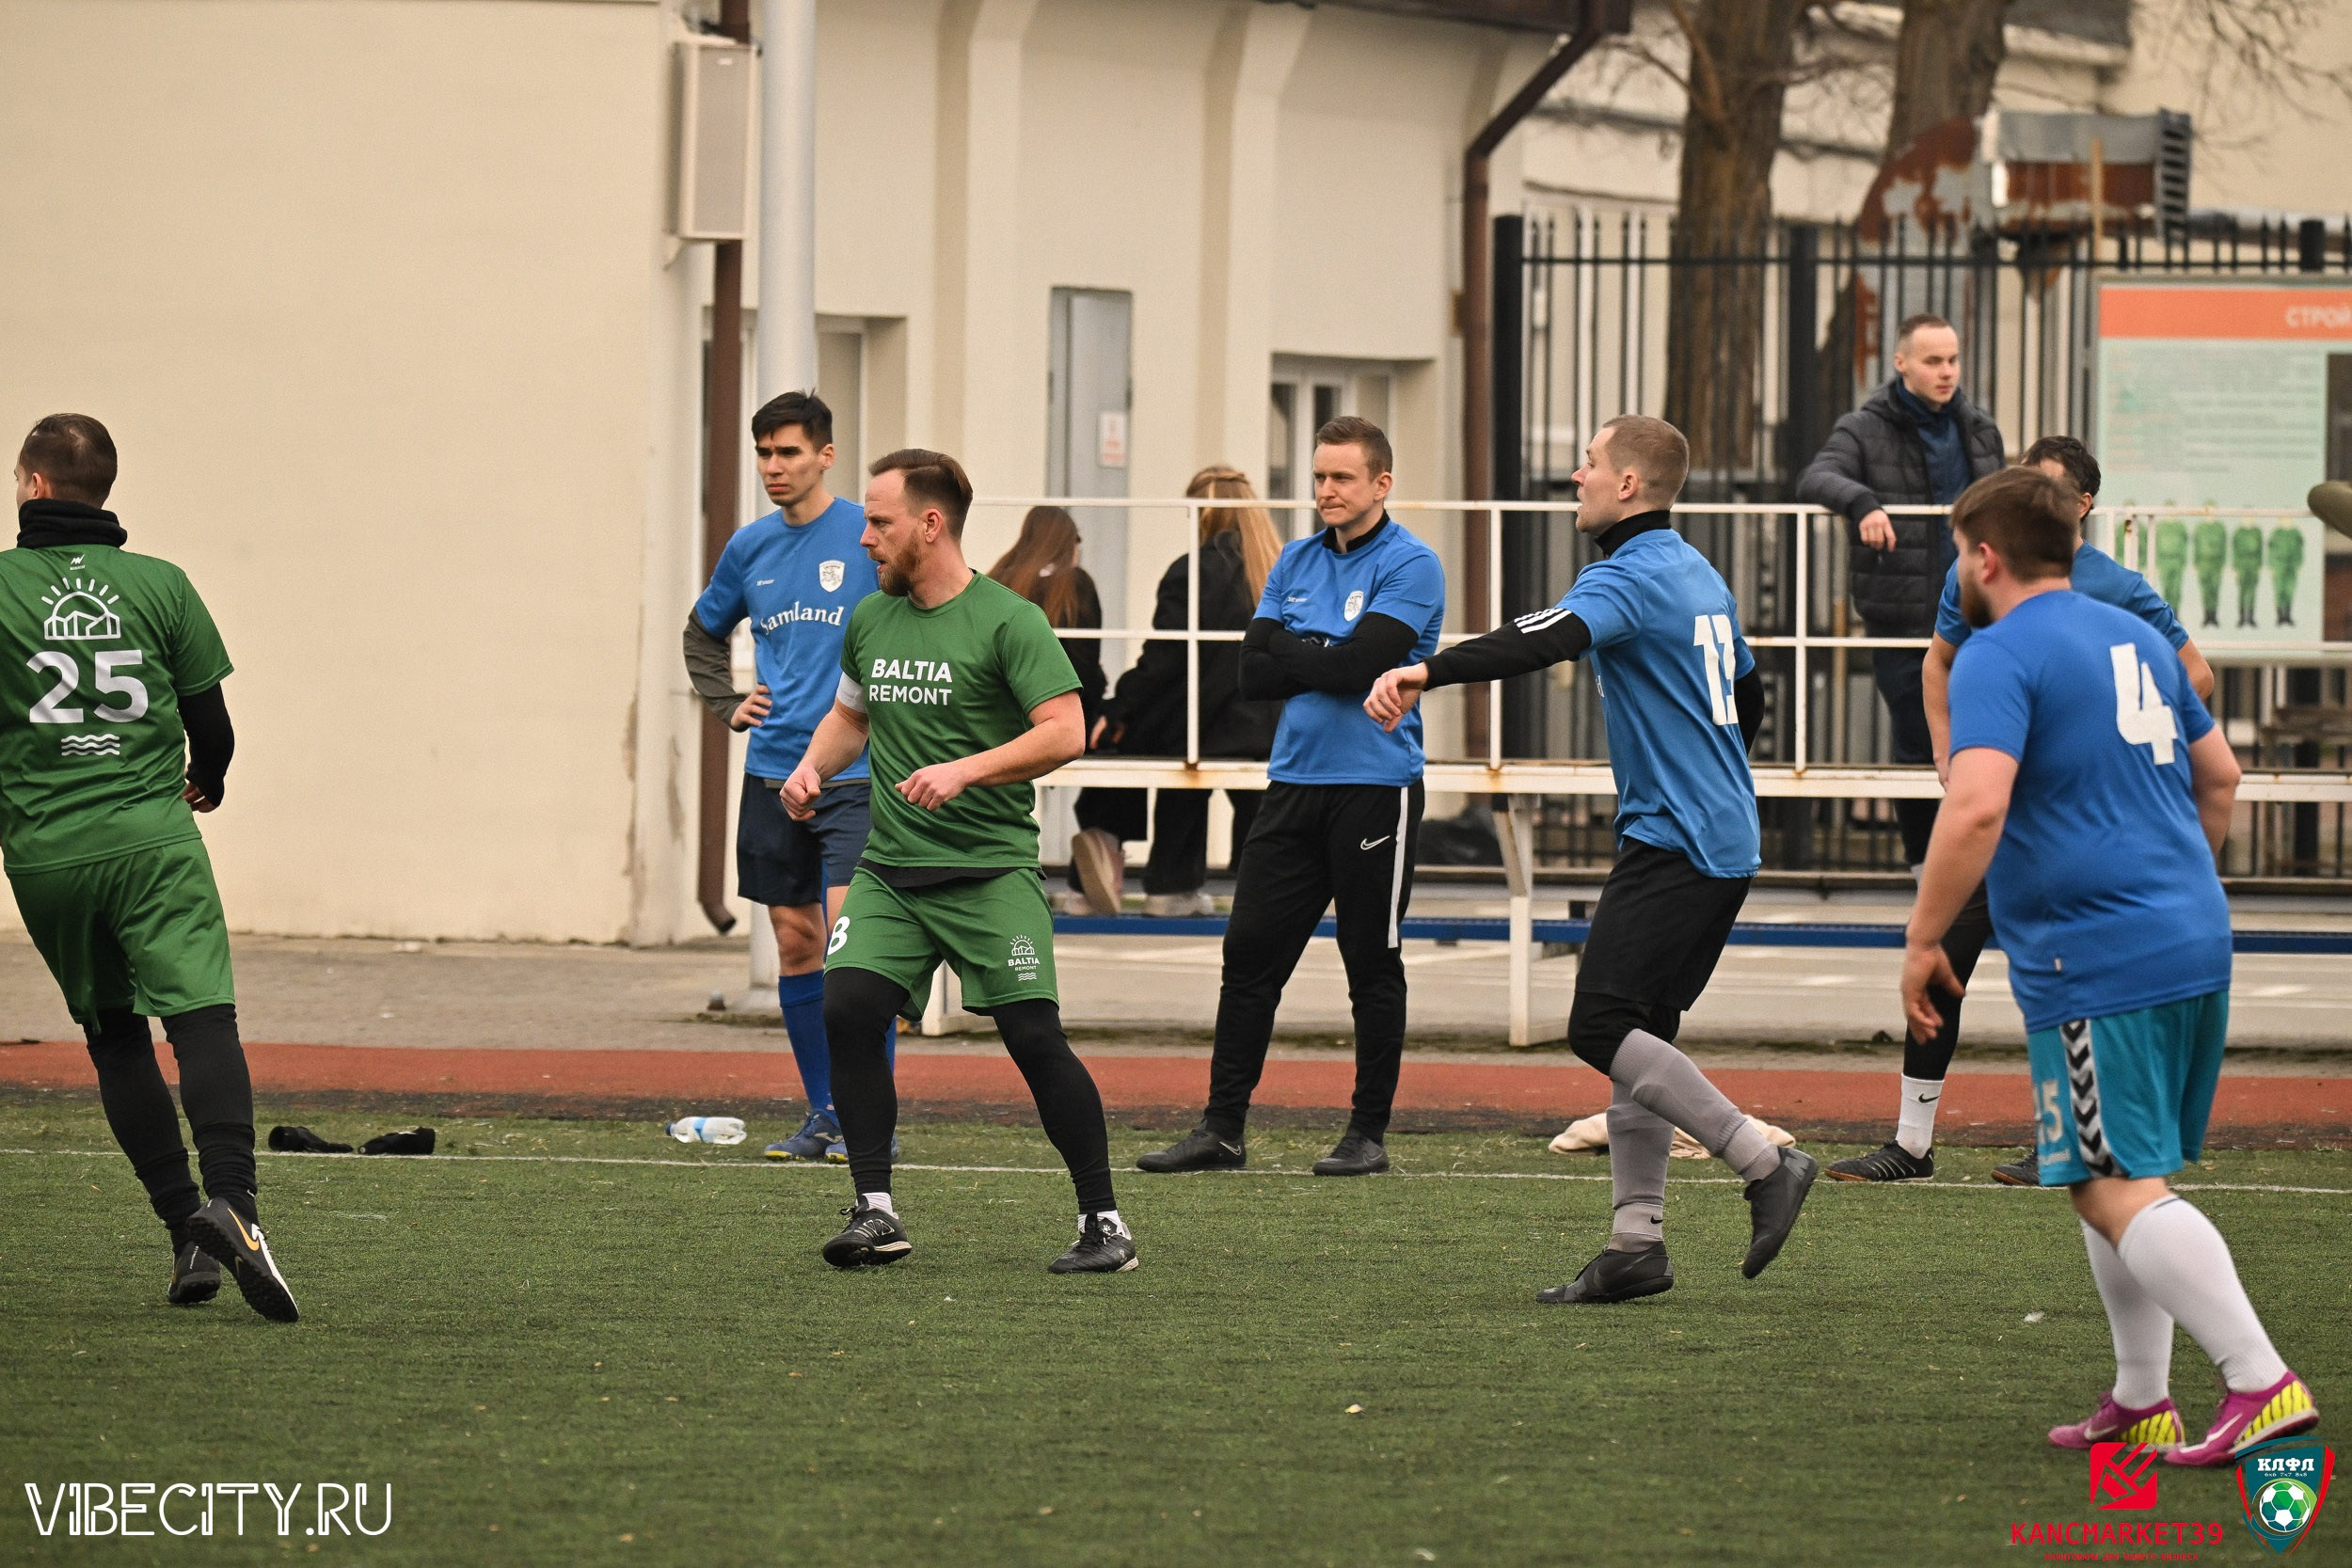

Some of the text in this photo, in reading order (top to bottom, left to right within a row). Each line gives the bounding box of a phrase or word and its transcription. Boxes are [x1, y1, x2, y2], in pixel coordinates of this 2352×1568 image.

[760, 600, 844, 636] Samland
[871, 658, 953, 683] BALTIA
[26, 649, 148, 723] 25
[868, 684, 952, 706] REMONT
[2109, 642, 2178, 766] 4
[1008, 957, 1041, 967] BALTIA
